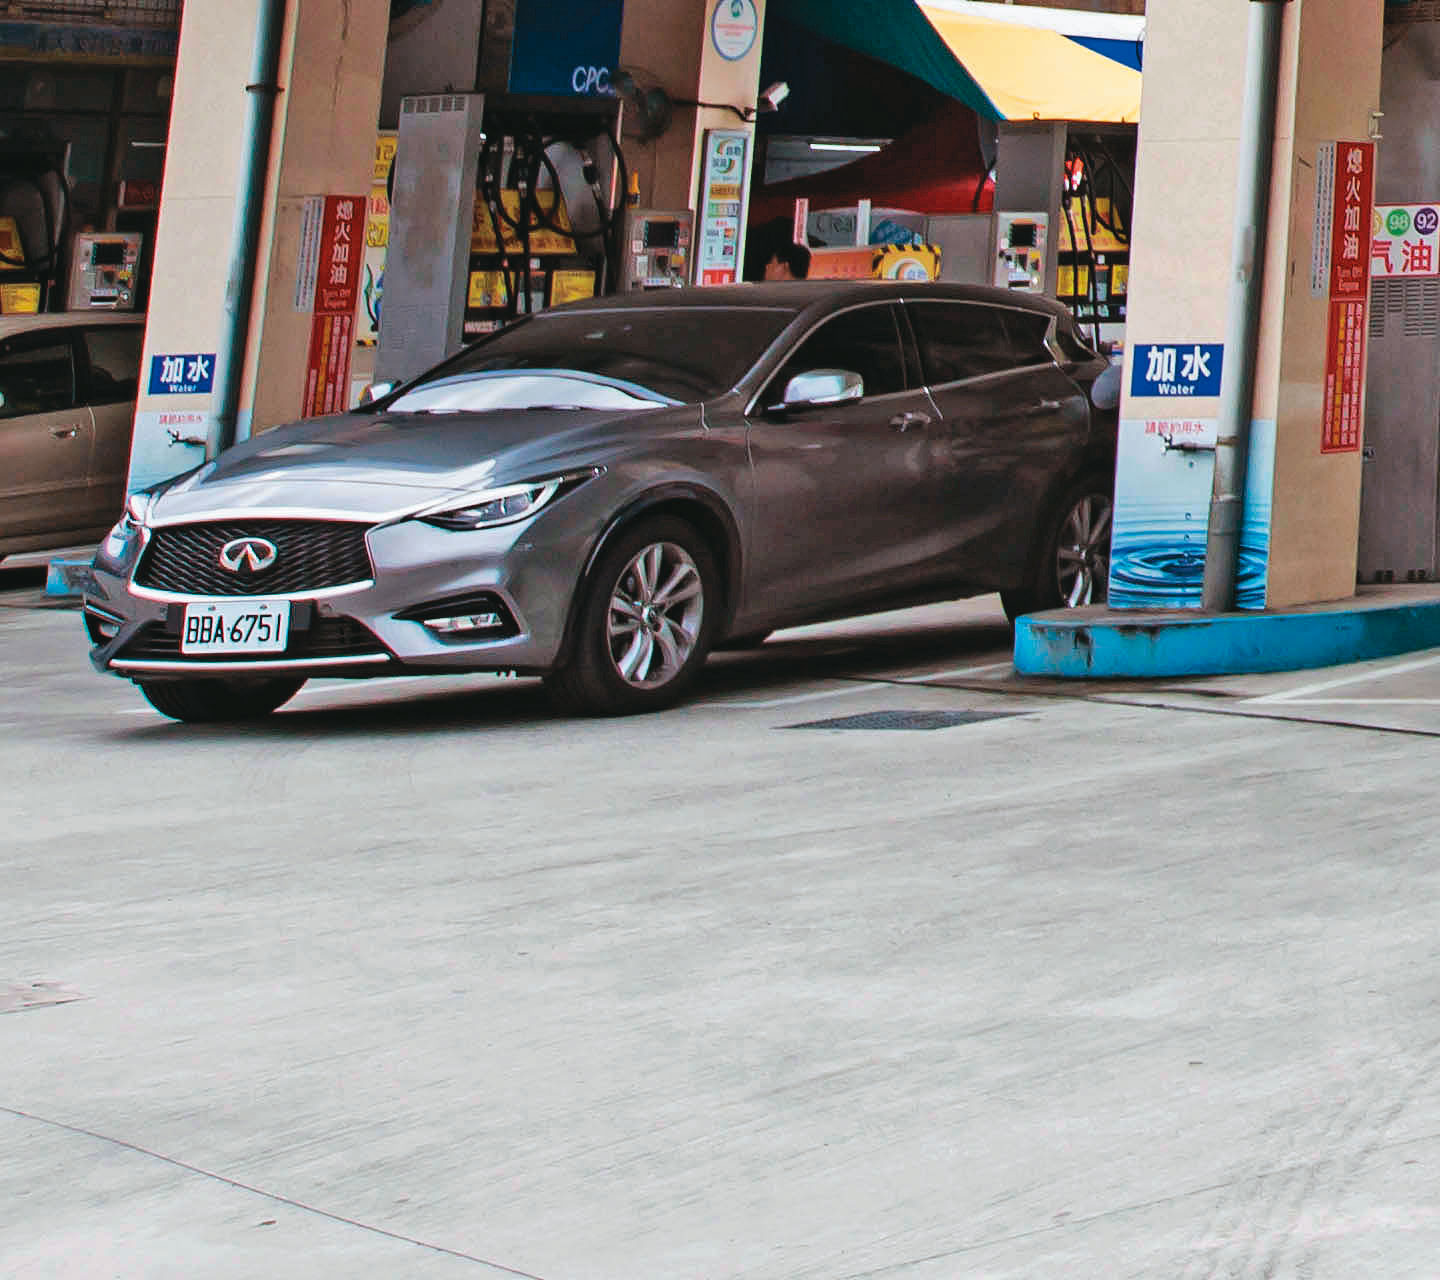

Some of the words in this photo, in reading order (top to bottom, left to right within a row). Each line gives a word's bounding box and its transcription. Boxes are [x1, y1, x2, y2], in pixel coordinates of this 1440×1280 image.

[1388, 212, 1410, 230] 98
[1415, 211, 1438, 231] 92
[159, 356, 210, 384] 加水
[1146, 345, 1212, 383] 加水
[1157, 383, 1196, 396] Water
